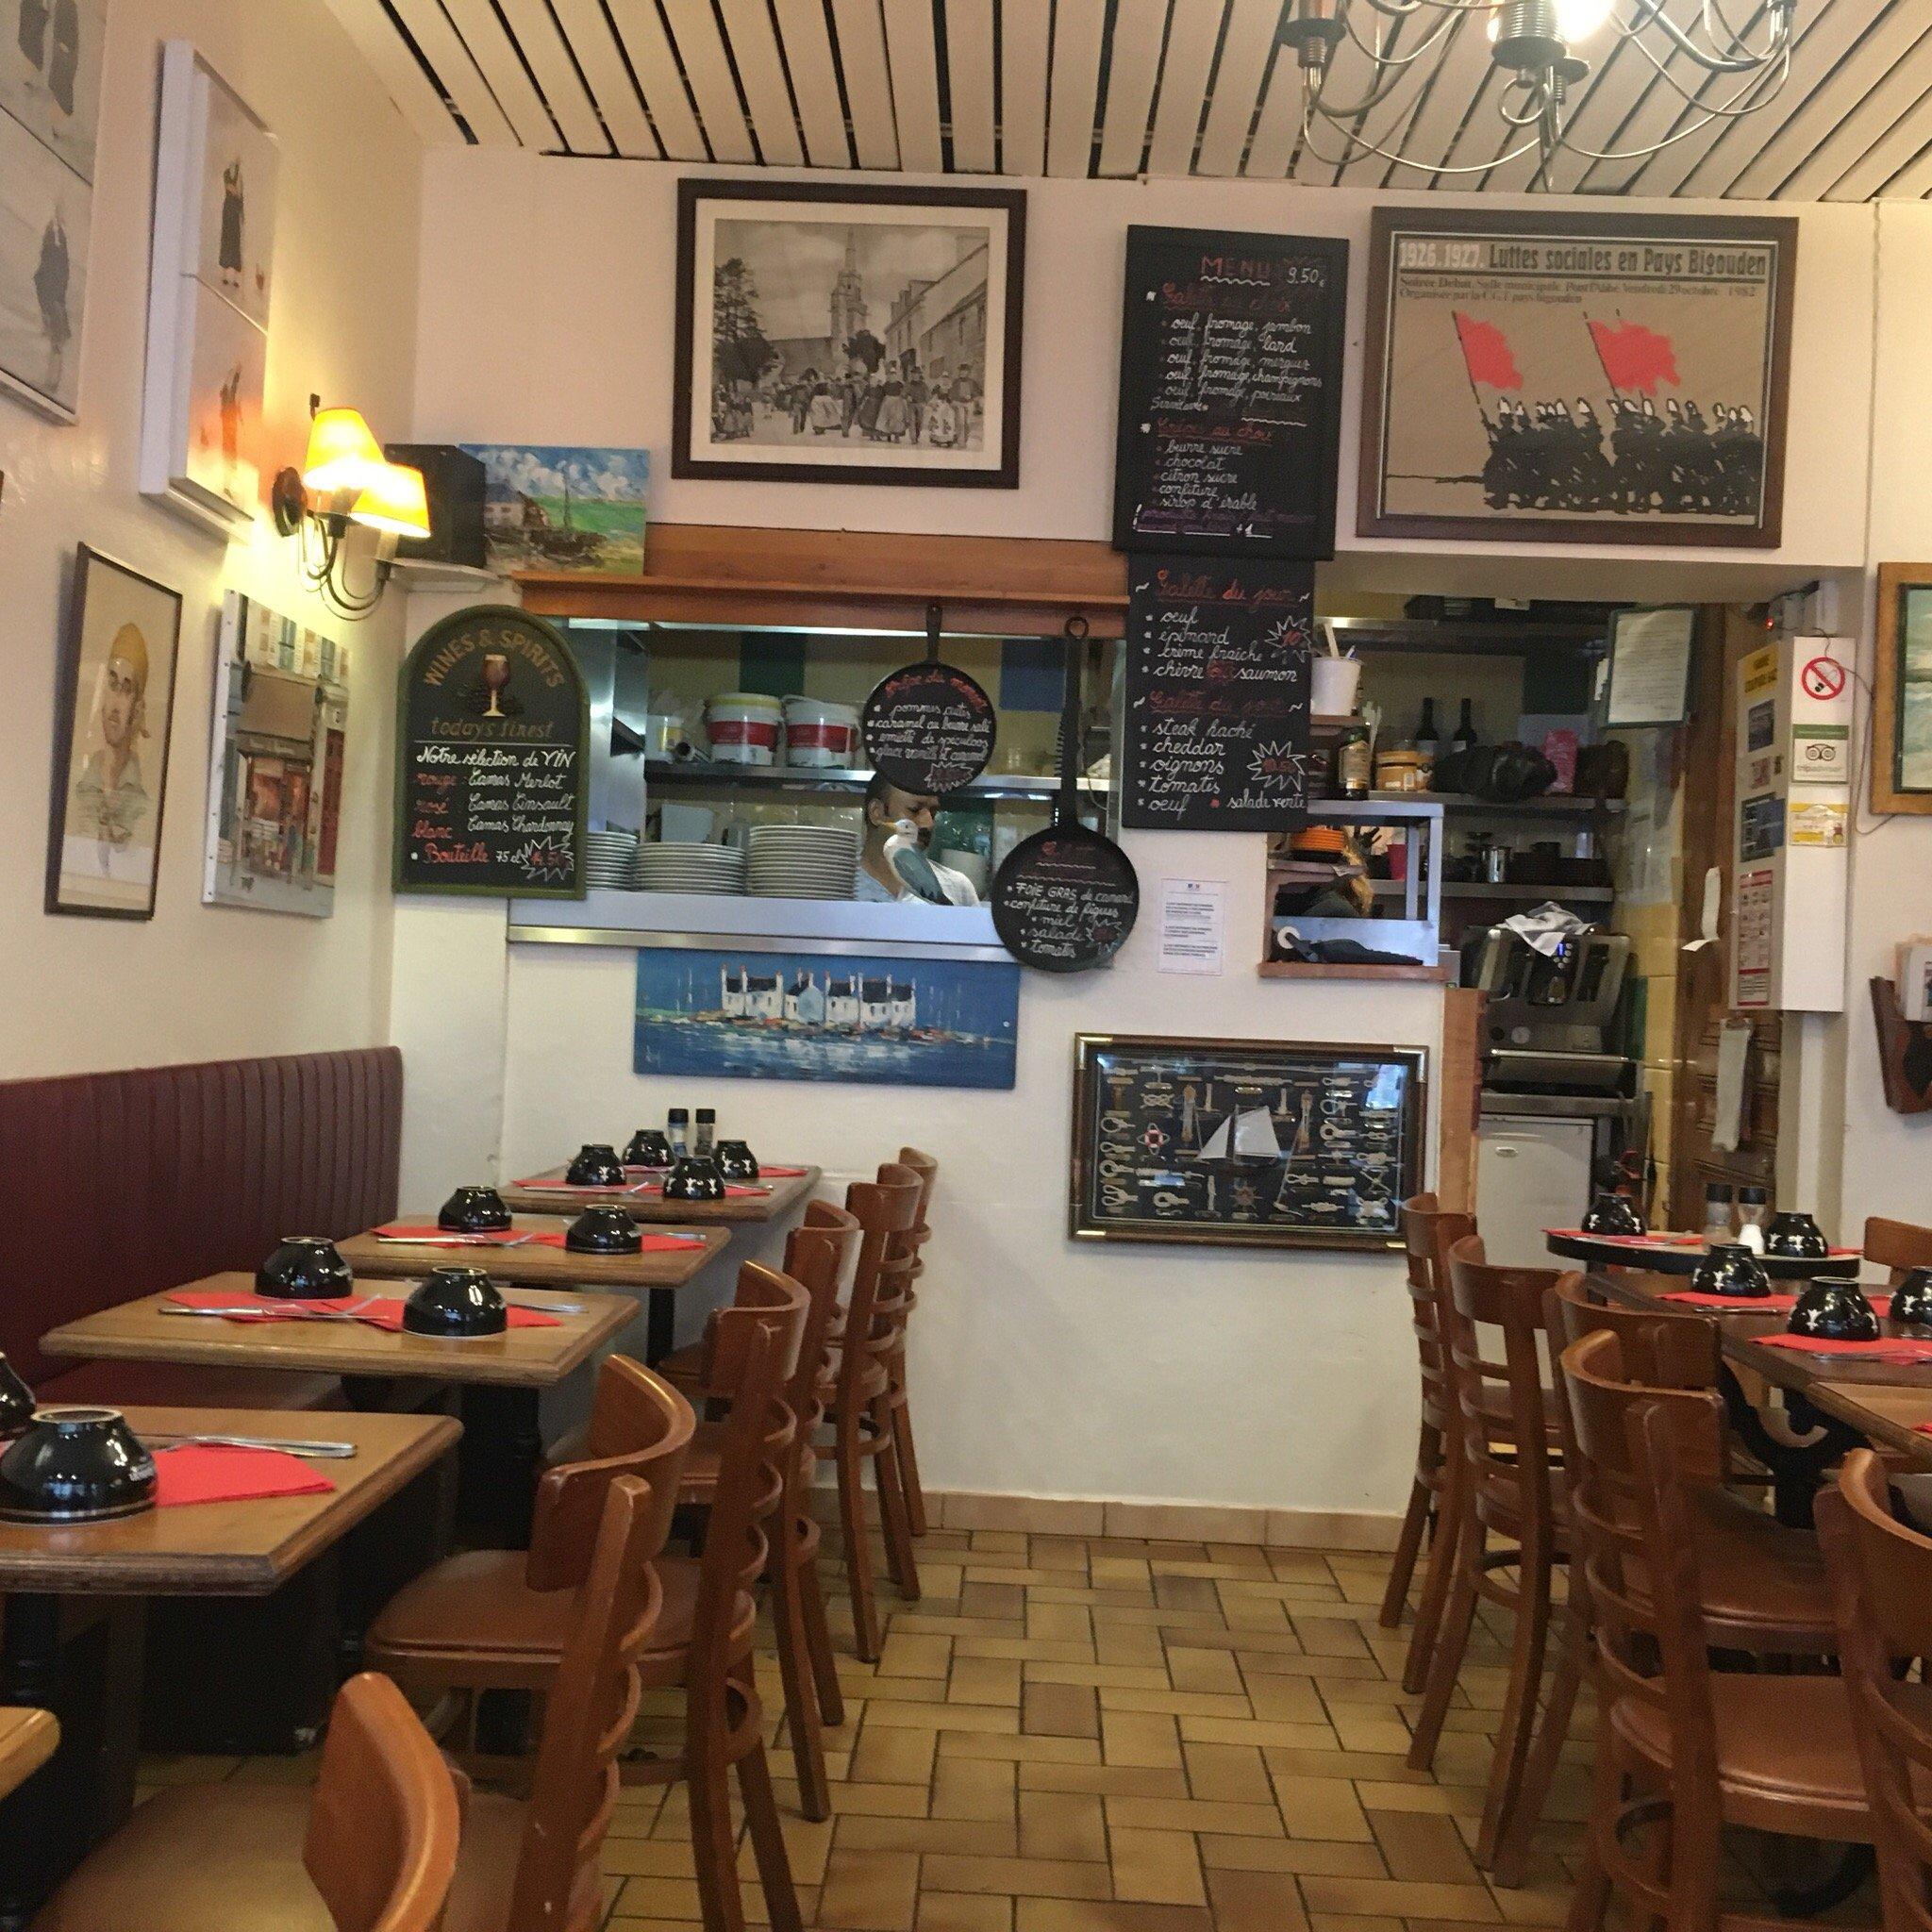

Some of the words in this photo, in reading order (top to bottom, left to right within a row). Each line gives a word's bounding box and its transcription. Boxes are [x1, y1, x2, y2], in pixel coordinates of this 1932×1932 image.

[1201, 256, 1272, 280] MENU
[1490, 243, 1539, 270] Luttes
[1545, 246, 1612, 272] sociales
[1619, 251, 1638, 272] en
[1643, 247, 1683, 275] Pays
[1688, 249, 1766, 276] Bigouden
[1261, 335, 1297, 354] lard
[1164, 440, 1206, 456] beurre
[1164, 456, 1226, 471] chocolat
[1159, 470, 1201, 484] citron
[1158, 495, 1197, 512] sirop
[425, 631, 475, 687] WINES
[478, 628, 494, 647] &
[499, 629, 566, 688] SPIRITS
[1158, 644, 1205, 660] crème
[1153, 659, 1205, 680] chèvre
[1234, 665, 1298, 683] saumon
[431, 718, 494, 741] today's
[500, 719, 555, 739] finest
[874, 714, 925, 730] caramel
[1152, 717, 1199, 737] steak
[1207, 719, 1257, 740] haché
[921, 730, 936, 745] de
[1152, 736, 1227, 757] cheddar
[415, 745, 461, 765] Notre
[461, 748, 520, 768] sélection
[522, 751, 540, 768] de
[1149, 757, 1225, 781] oignons
[514, 772, 567, 790] Merlot
[1148, 775, 1222, 795] tomates
[1226, 789, 1272, 809] salade
[1274, 792, 1309, 809] verte
[495, 849, 510, 863] 75
[1015, 881, 1044, 897] FOIE
[1047, 886, 1077, 901] GRAS
[1079, 888, 1093, 901] de
[1008, 897, 1062, 916] confiture
[1064, 899, 1078, 914] de
[1078, 902, 1120, 923] figues
[1041, 914, 1075, 927] miel
[1026, 925, 1086, 941] salade
